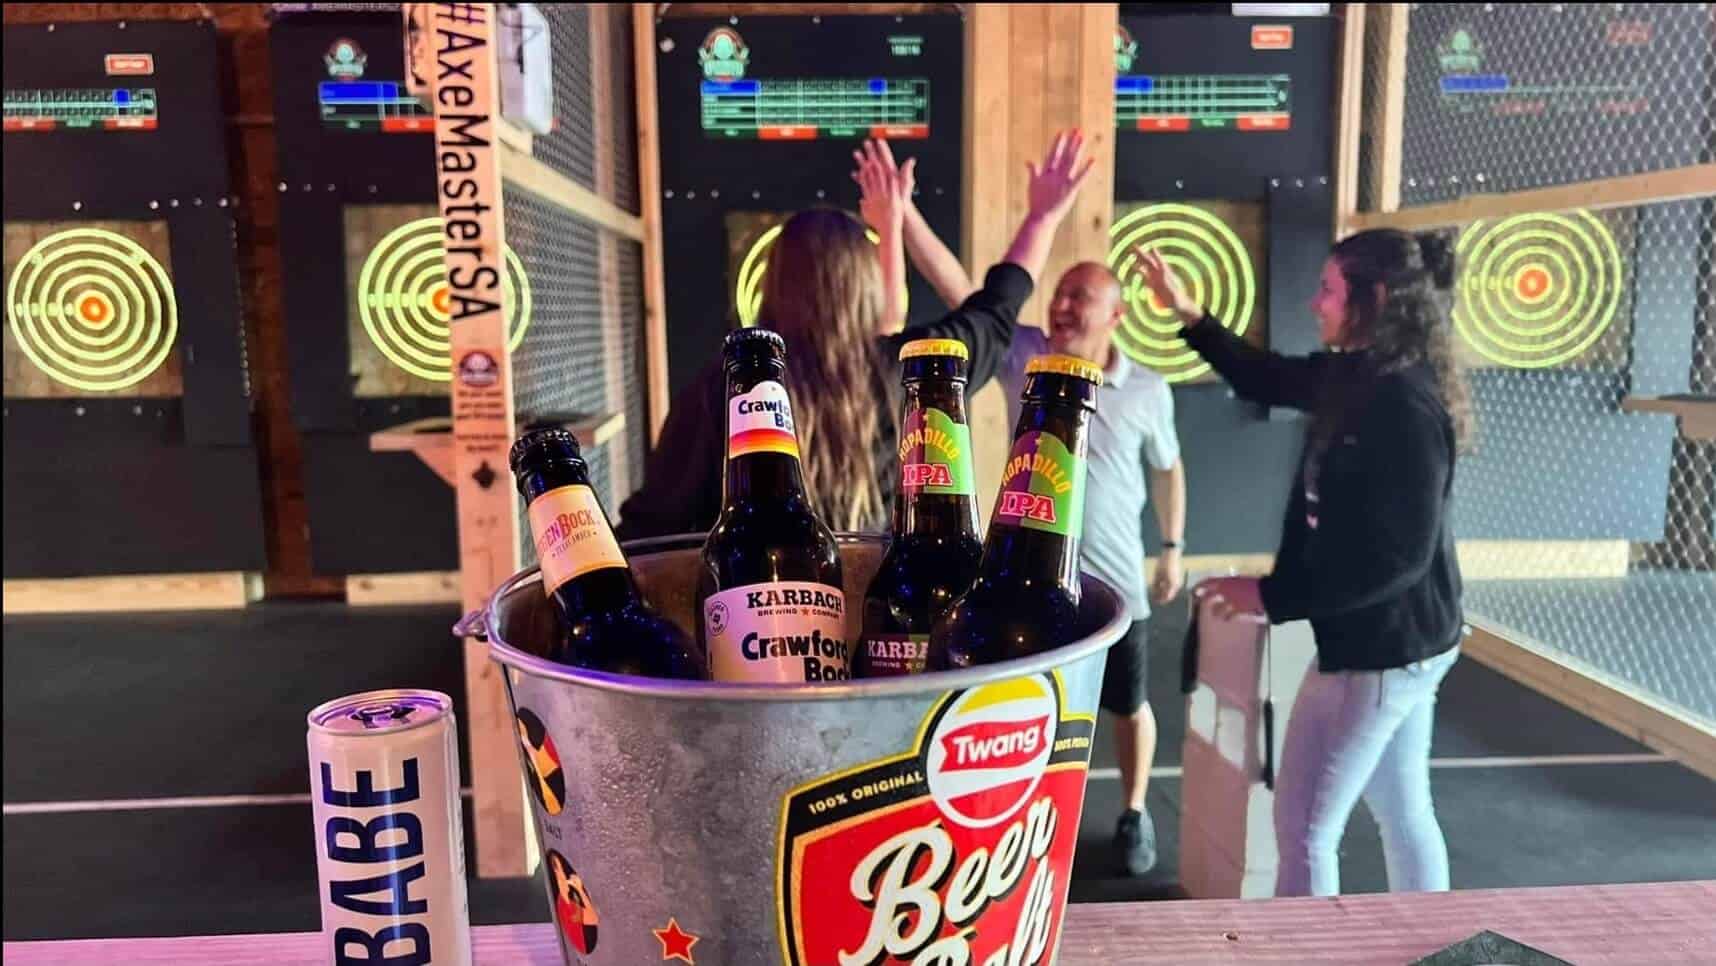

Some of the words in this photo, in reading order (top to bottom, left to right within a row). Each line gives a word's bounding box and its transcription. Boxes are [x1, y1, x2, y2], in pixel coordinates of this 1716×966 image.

[435, 4, 501, 320] #AxeMasterSA
[903, 463, 952, 487] IPA
[1000, 490, 1057, 523] IPA
[746, 589, 843, 613] KARBACH
[757, 607, 798, 617] BREWING
[953, 726, 1040, 765] Twang
[808, 793, 848, 815] 100%
[851, 771, 924, 801] ORIGINAL
[320, 757, 431, 966] BABE
[838, 797, 1057, 966] Beer
